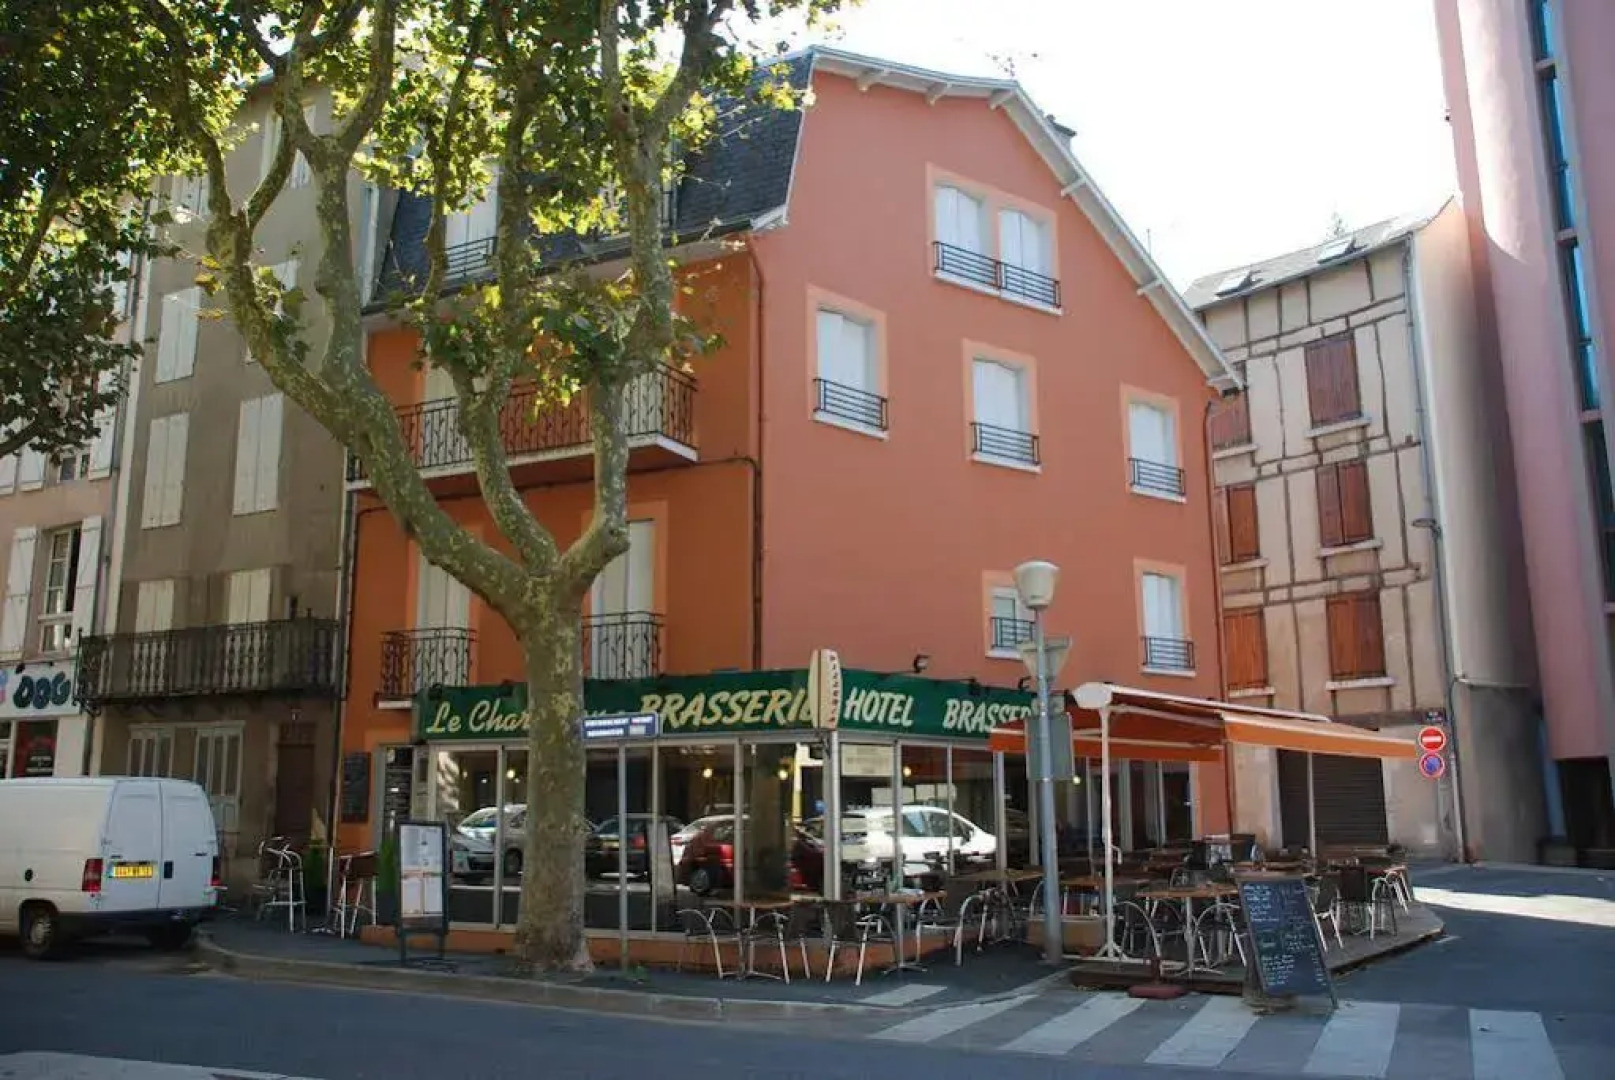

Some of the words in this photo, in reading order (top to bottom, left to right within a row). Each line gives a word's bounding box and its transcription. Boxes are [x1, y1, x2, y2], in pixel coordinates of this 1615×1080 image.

[426, 701, 462, 733] Le
[843, 687, 914, 727] HOTEL
[942, 699, 1033, 733] BRASSER
